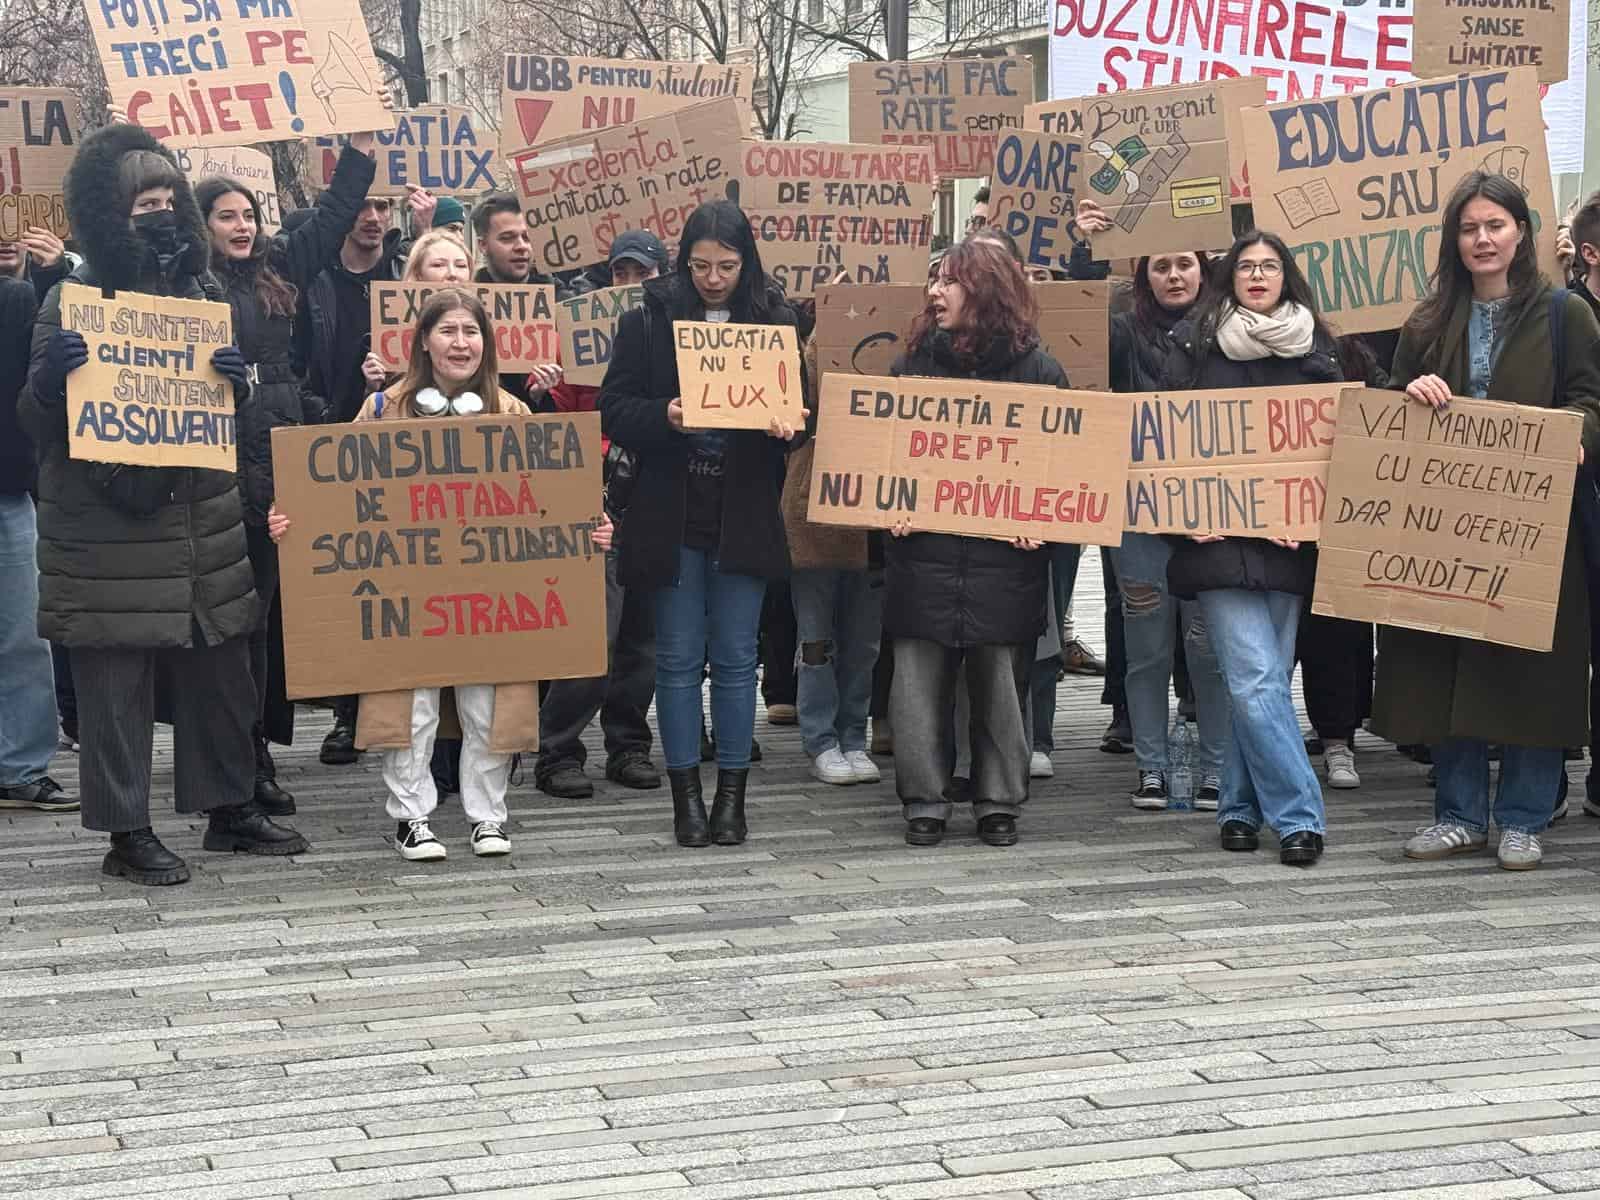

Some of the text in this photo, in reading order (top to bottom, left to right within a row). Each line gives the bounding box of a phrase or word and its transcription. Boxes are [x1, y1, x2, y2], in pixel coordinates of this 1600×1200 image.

[111, 27, 314, 77] TRECI PE
[1054, 0, 1412, 72] BUZUNARELE
[1448, 42, 1542, 67] LIMITATE
[507, 55, 573, 91] UBB
[577, 65, 652, 89] PENTRU
[963, 60, 1017, 96] FAC
[22, 100, 73, 145] LA
[583, 96, 635, 128] NU
[881, 97, 959, 132] RATE
[1088, 93, 1216, 139] Bun venit
[1269, 72, 1509, 172] EDUCAȚIE
[388, 150, 407, 185] E
[418, 150, 497, 189] LUX
[744, 146, 932, 185] CONSULTAREA
[997, 134, 1082, 194] OARE
[525, 183, 630, 229] achitată
[637, 175, 660, 198] în
[778, 181, 911, 211] DE FAȚADĂ
[1020, 191, 1075, 216] O SĂ
[1358, 167, 1439, 221] SAU
[543, 226, 581, 268] de
[750, 214, 835, 242] SCOATE
[816, 243, 841, 265] ÎN
[69, 303, 228, 344] NU SUNTEM
[496, 324, 554, 361] COST
[97, 341, 195, 376] CLIENȚI
[700, 355, 752, 372] NU E
[113, 368, 225, 407] SUNTEM
[75, 401, 236, 453] ABSOLVENȚI
[850, 389, 1083, 435] EDUCAȚIA E UN
[1168, 399, 1257, 460] MULTE
[1359, 398, 1410, 441] VĂ
[308, 421, 584, 482] CONSULTAREA
[1376, 454, 1410, 482] CU
[355, 487, 388, 523] DE
[819, 472, 1109, 523] NU UN PRIVILEGIU
[1334, 496, 1391, 526] DAR
[1403, 503, 1443, 532] NU
[312, 528, 442, 575] SCOATE
[352, 577, 568, 641] ÎN STRADĂ
